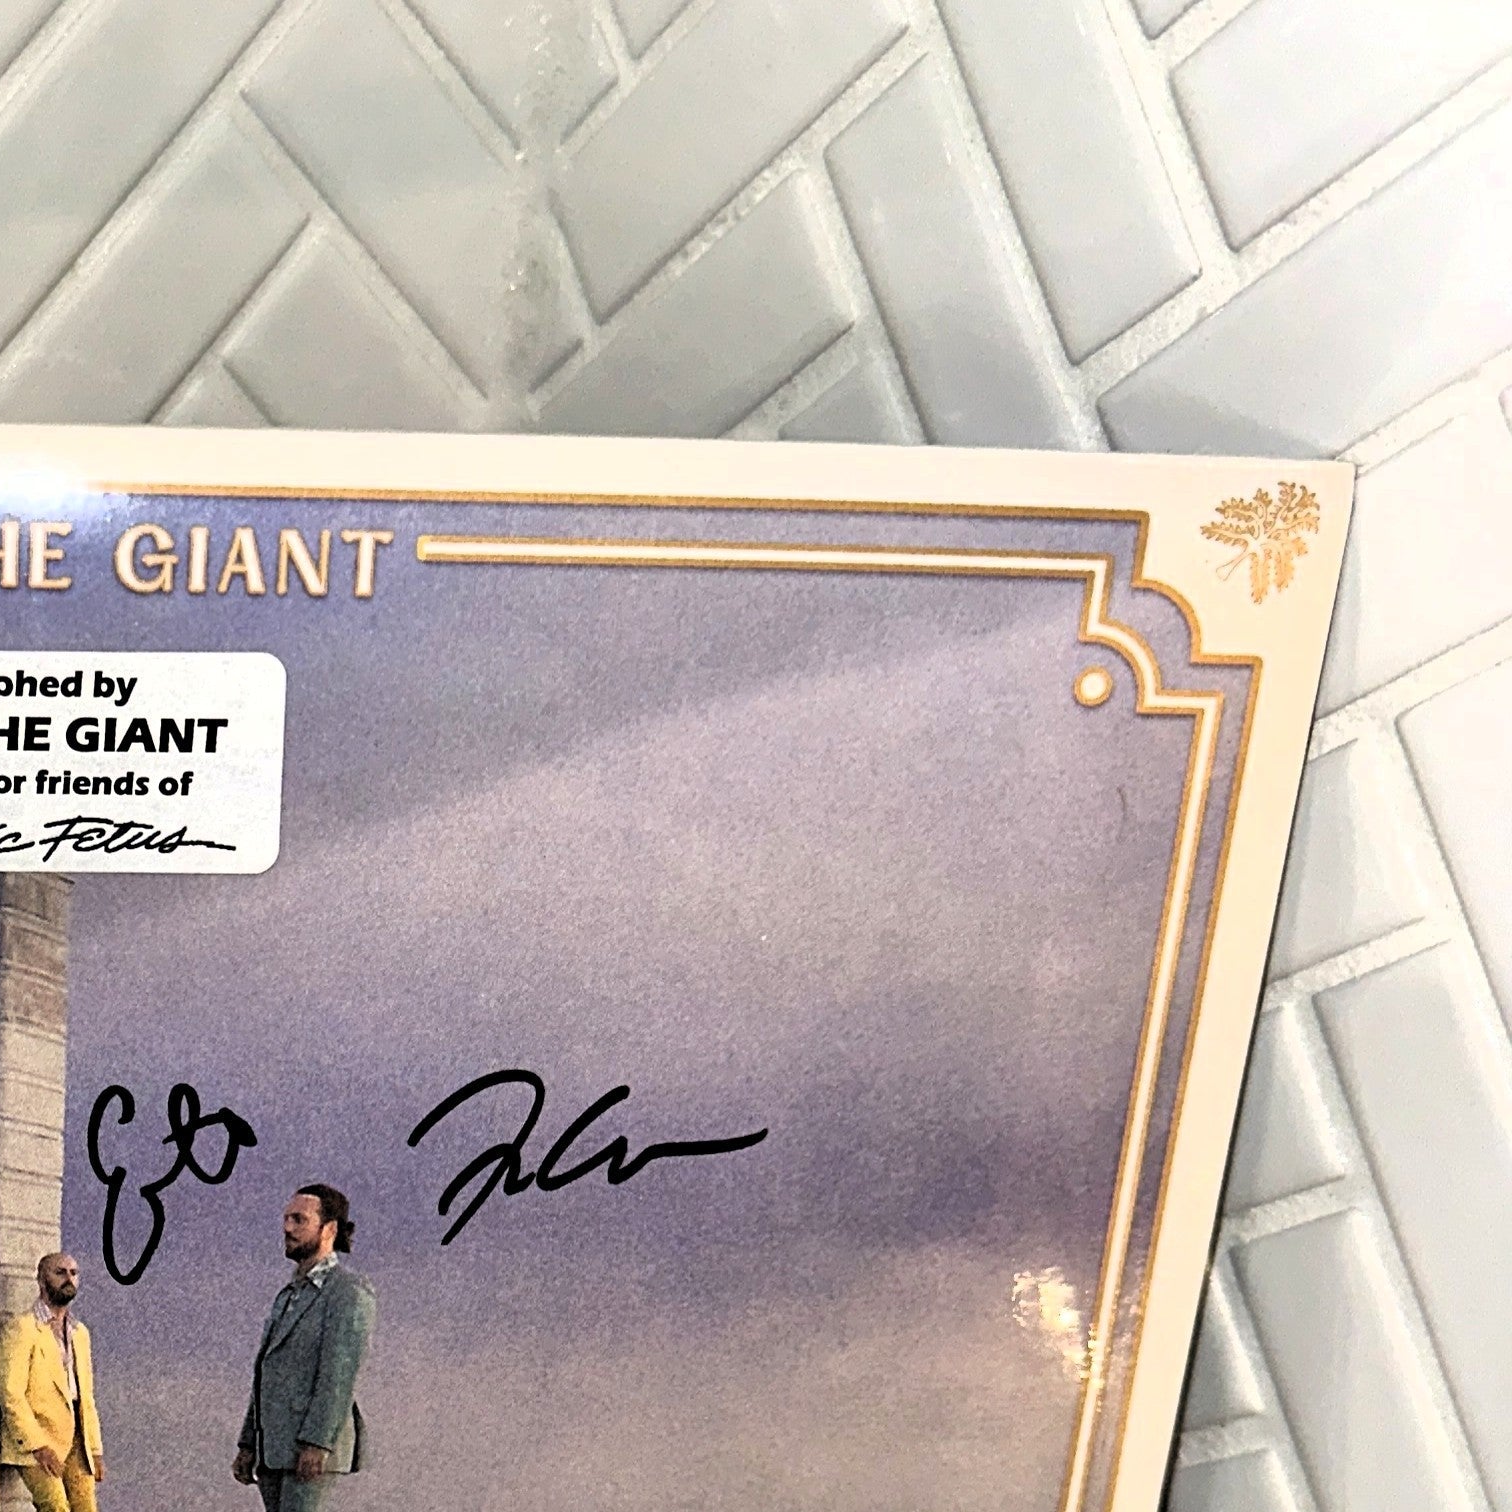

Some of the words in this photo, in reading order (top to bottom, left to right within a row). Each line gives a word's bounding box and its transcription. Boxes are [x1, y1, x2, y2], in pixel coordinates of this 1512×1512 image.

[113, 522, 394, 600] GIANT
[92, 672, 138, 706] by
[65, 717, 228, 754] GIANT
[35, 771, 150, 796] friends
[158, 771, 194, 796] of
[38, 815, 237, 863] Fetus
